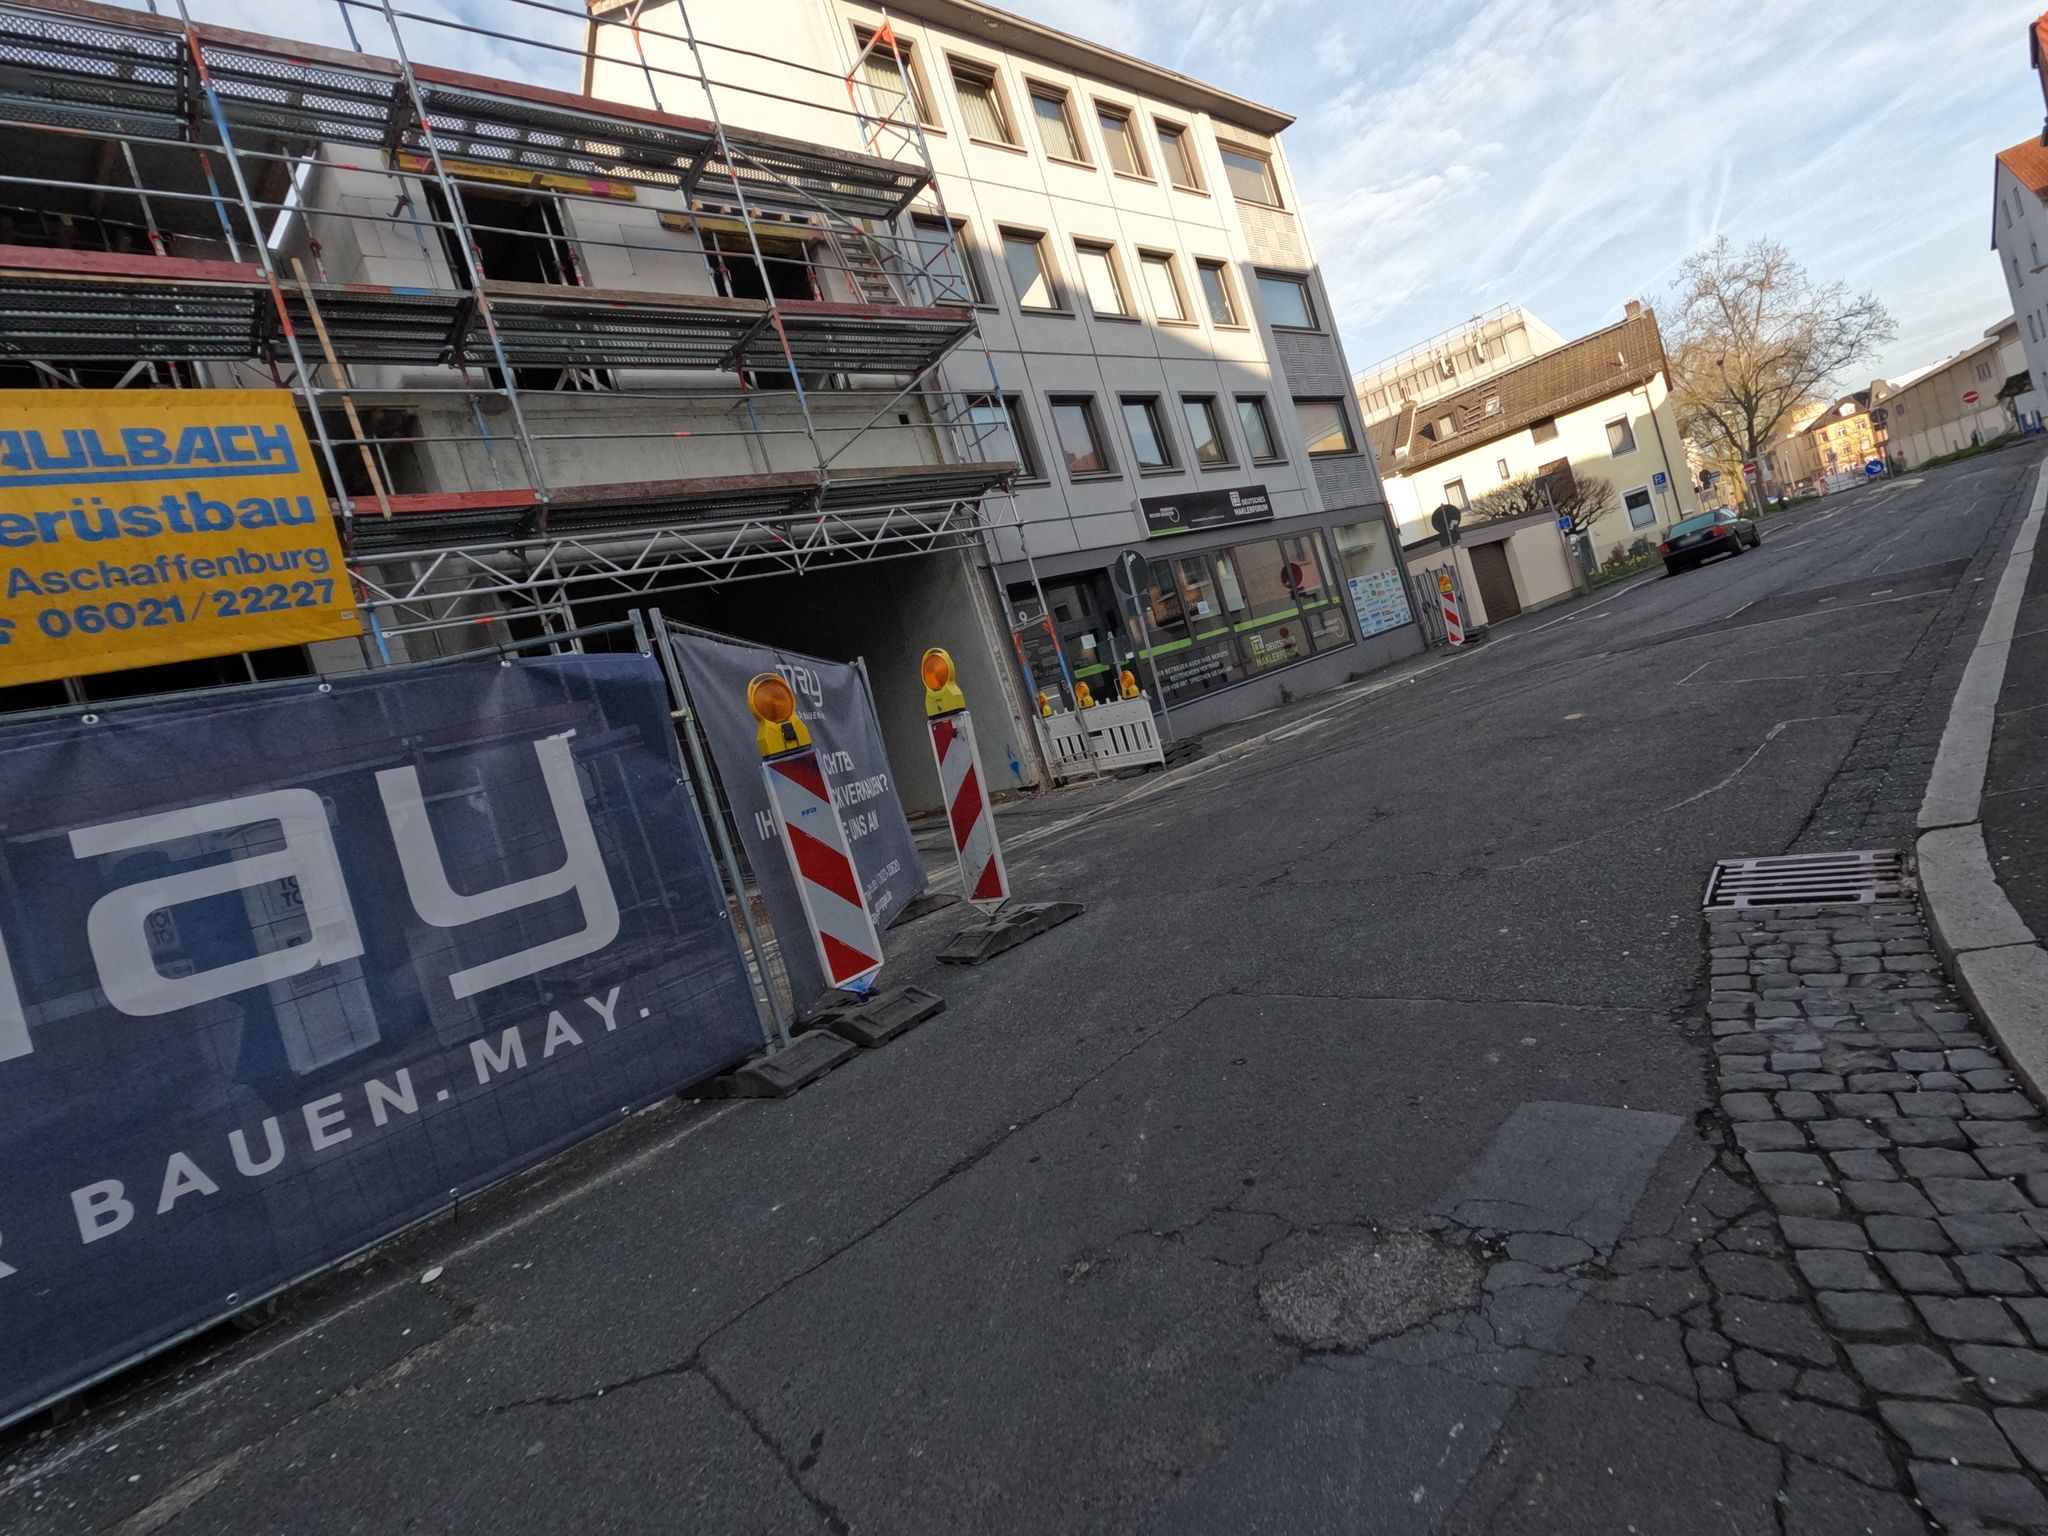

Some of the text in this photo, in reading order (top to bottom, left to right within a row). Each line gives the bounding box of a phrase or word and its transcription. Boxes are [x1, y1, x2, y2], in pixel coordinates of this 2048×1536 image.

[0, 424, 299, 473] AULBACH
[0, 491, 316, 548] erüstbau
[1234, 504, 1269, 516] MAKLERFORUM
[1241, 496, 1266, 506] DEUTSCHES
[6, 547, 331, 599] Aschaffenburg
[37, 578, 335, 640] 06021/22227
[754, 808, 777, 840] IH
[0, 734, 621, 1062] ay
[70, 987, 652, 1245] BAUEN. MAY.
